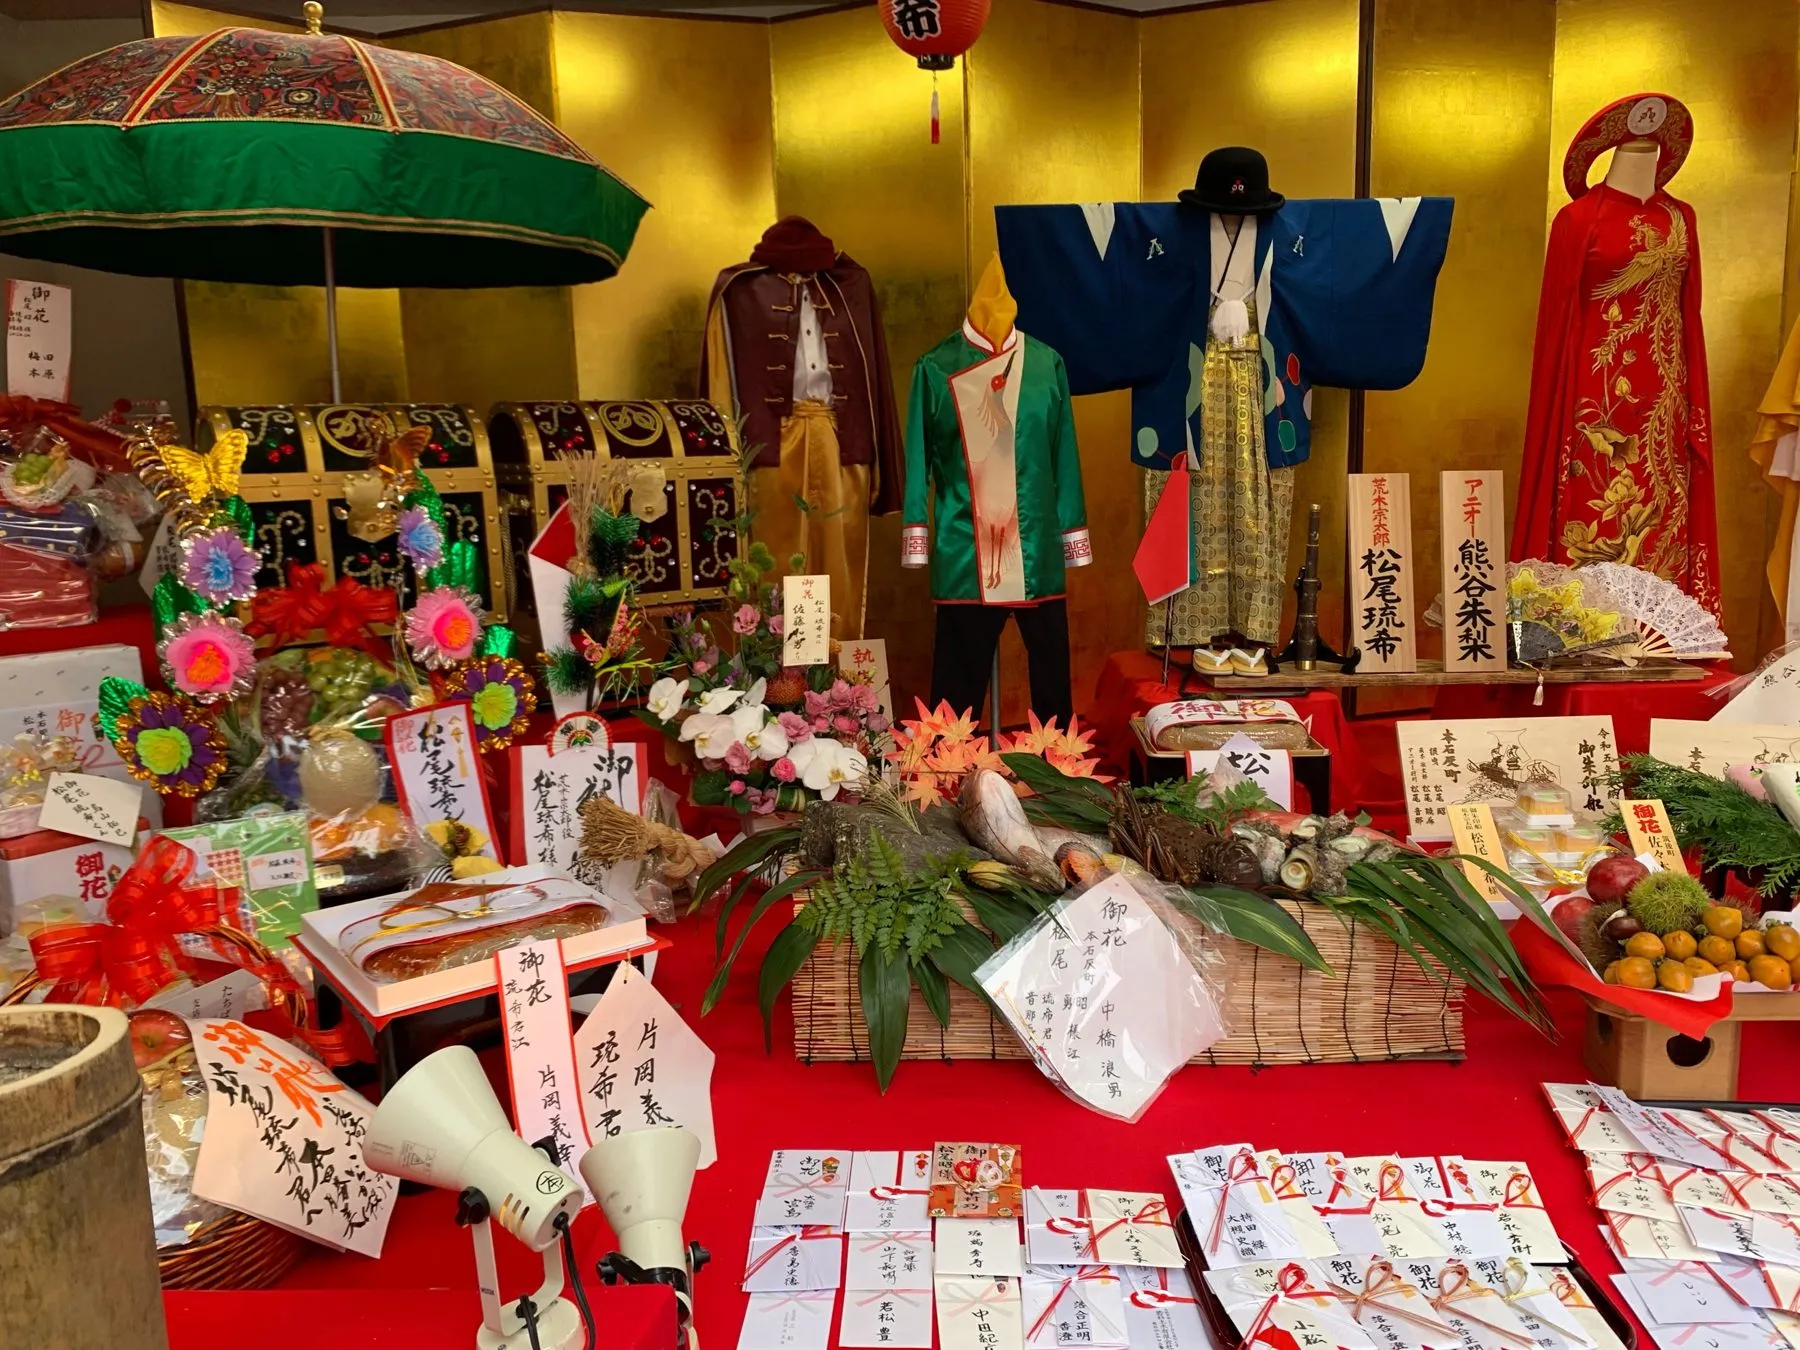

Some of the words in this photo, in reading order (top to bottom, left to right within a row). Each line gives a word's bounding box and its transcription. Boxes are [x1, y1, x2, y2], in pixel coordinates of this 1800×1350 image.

[1371, 477, 1390, 547] 荒木宗太郎
[1462, 479, 1484, 538] アニオー
[1360, 548, 1406, 664] 松尾琉希
[1453, 538, 1498, 663] 熊谷朱梨
[1441, 728, 1461, 783] 本石灰町
[531, 768, 561, 868] 松尾琉希様
[1632, 803, 1663, 835] 御花
[74, 850, 109, 902] 御花
[1049, 925, 1071, 970] 松尾
[1101, 896, 1128, 947] 御花
[518, 947, 552, 1007] 御花
[1082, 930, 1100, 985] 本石灰町
[634, 1017, 685, 1129] 片岡義
[1413, 1162, 1441, 1190] 御花
[1331, 1260, 1362, 1286] 御花
[1408, 1264, 1440, 1291] 御花
[1475, 1259, 1506, 1285] 御花
[1073, 1300, 1092, 1342] 落合正明
